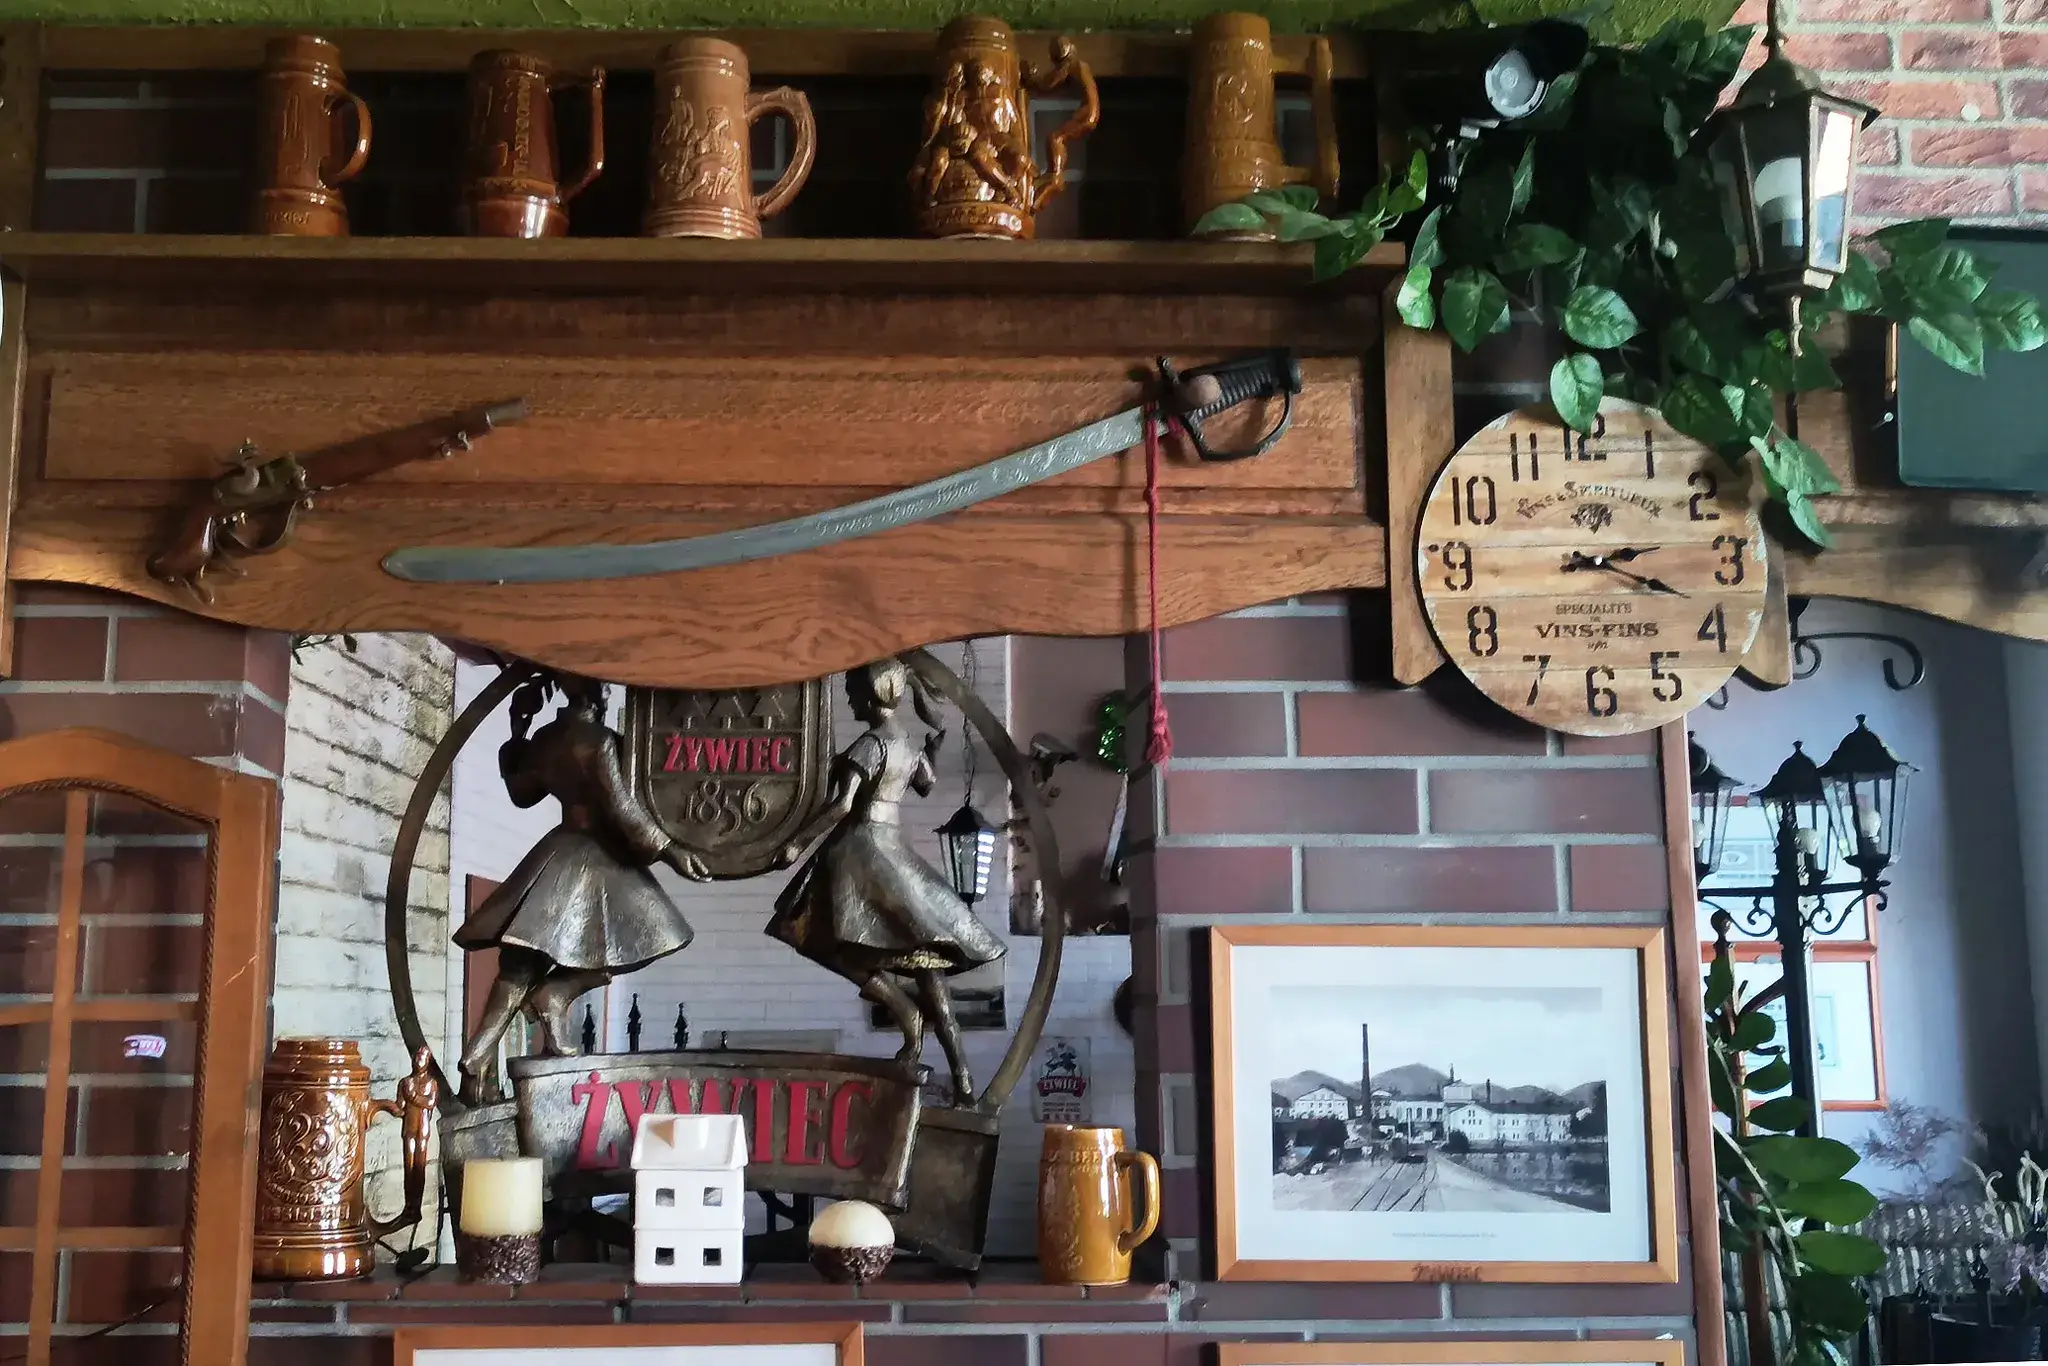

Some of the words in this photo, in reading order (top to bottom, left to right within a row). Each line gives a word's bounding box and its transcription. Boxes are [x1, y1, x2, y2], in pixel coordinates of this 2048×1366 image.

[1510, 432, 1539, 482] 11
[1644, 429, 1655, 480] 1
[1451, 475, 1497, 526] 10
[1687, 471, 1720, 521] 2
[1442, 541, 1473, 591] 9
[1712, 535, 1747, 586] 3
[1467, 606, 1498, 657] 8
[1697, 603, 1727, 653] 4
[1522, 655, 1551, 706] 7
[1585, 665, 1617, 717] 6
[1651, 652, 1682, 701] 5
[662, 731, 795, 773] ŻYWIEC
[682, 777, 770, 836] 1856
